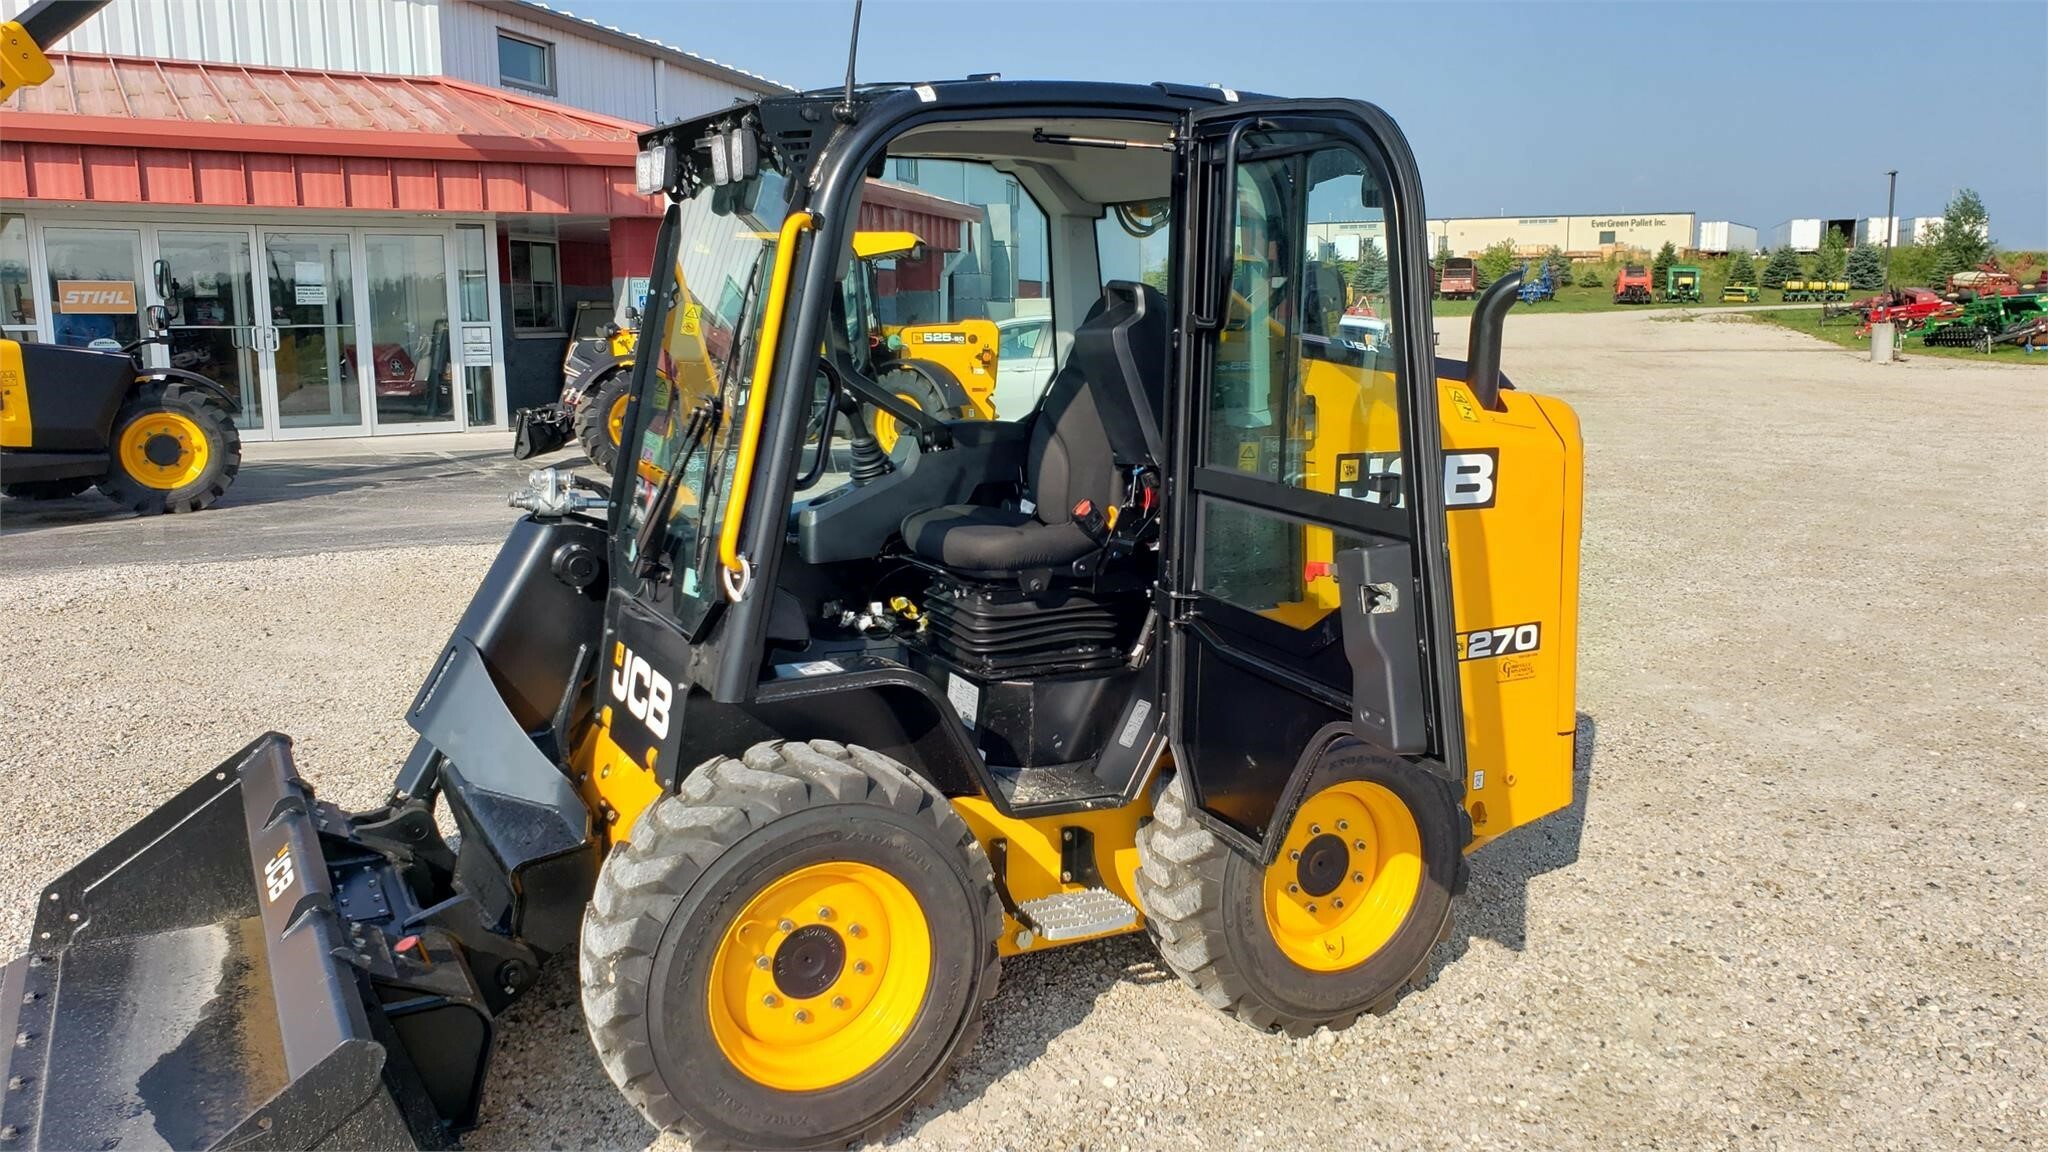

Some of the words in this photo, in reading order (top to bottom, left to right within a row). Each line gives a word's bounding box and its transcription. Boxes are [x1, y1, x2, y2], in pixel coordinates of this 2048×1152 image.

[1591, 219, 1629, 228] EverGreen
[1630, 218, 1653, 227] Pallet
[1654, 218, 1667, 226] Inc.
[64, 290, 130, 305] STIHL
[1468, 624, 1538, 659] 270
[612, 647, 673, 740] JCB
[264, 851, 295, 902] JCB
